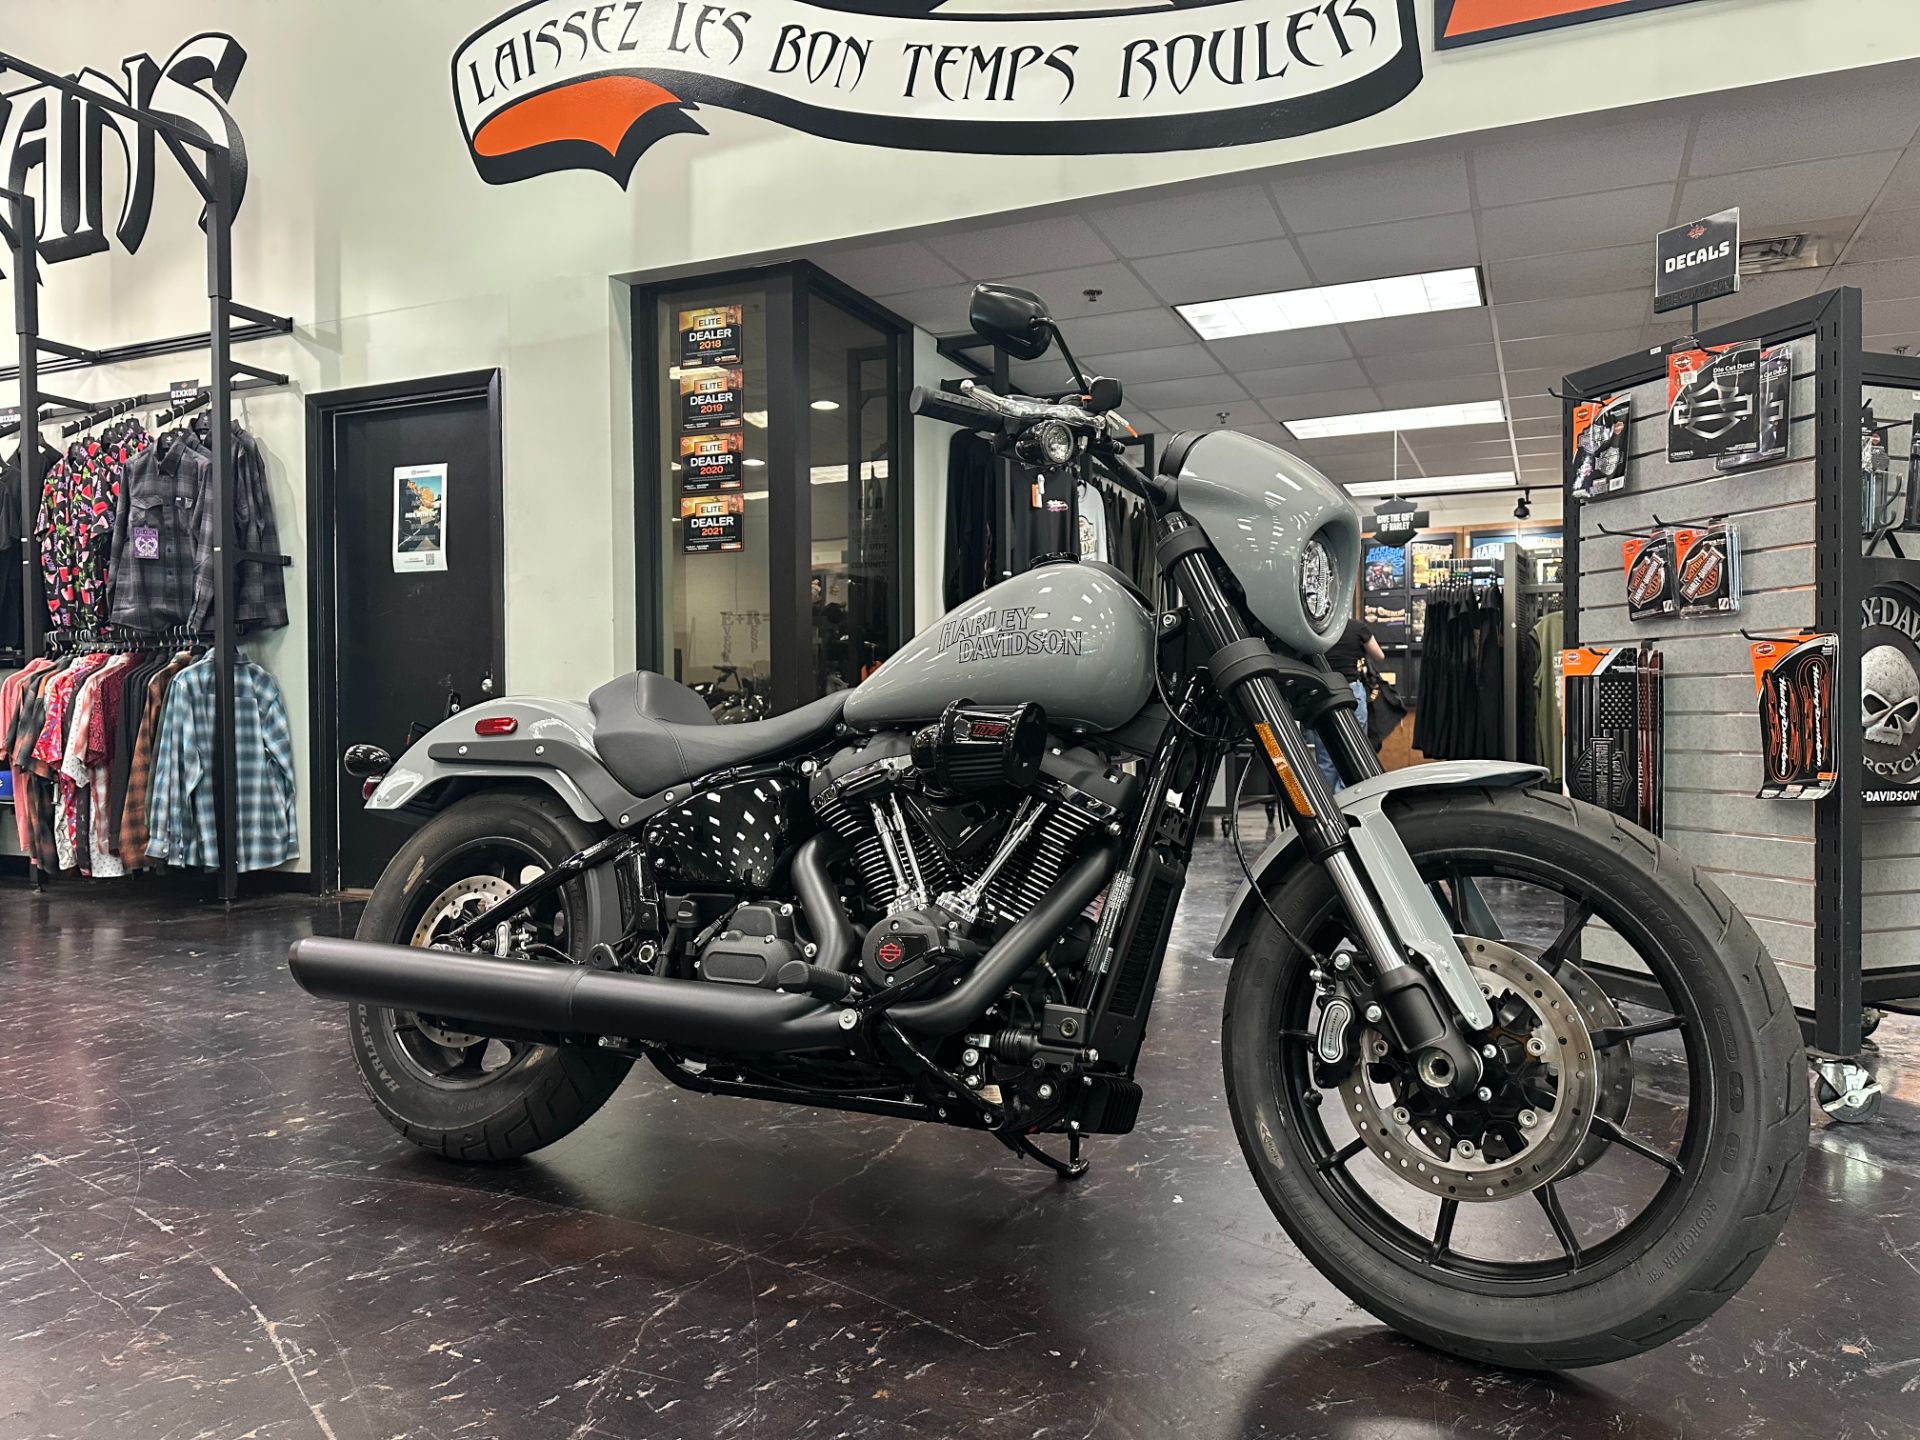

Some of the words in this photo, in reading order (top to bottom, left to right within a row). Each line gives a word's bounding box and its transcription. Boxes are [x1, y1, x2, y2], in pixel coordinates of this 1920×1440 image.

[468, 1, 643, 105] LAISSEZ
[667, 1, 752, 65] LES
[768, 24, 874, 93] BON
[903, 43, 1080, 105] TEMPS
[1118, 0, 1377, 101] ROULER
[1665, 240, 1730, 273] DECALS
[698, 317, 722, 328] ELITE
[689, 328, 733, 342] DEALER
[699, 340, 722, 350] 2018
[1737, 361, 1756, 369] Decal
[700, 381, 723, 391] ELITE
[690, 393, 733, 405] DEALER
[701, 404, 723, 413] 2019
[700, 444, 723, 453] ELITE
[690, 455, 733, 467] DEALER
[700, 466, 724, 475] 2020
[701, 505, 723, 514] ELITE
[691, 516, 734, 528] DEALER
[1390, 514, 1401, 522] THE
[1389, 521, 1410, 531] HARLEY
[702, 527, 724, 536] 2021
[959, 629, 1082, 663] DAVIDSON
[1663, 1198, 1717, 1270] SCORCHER
